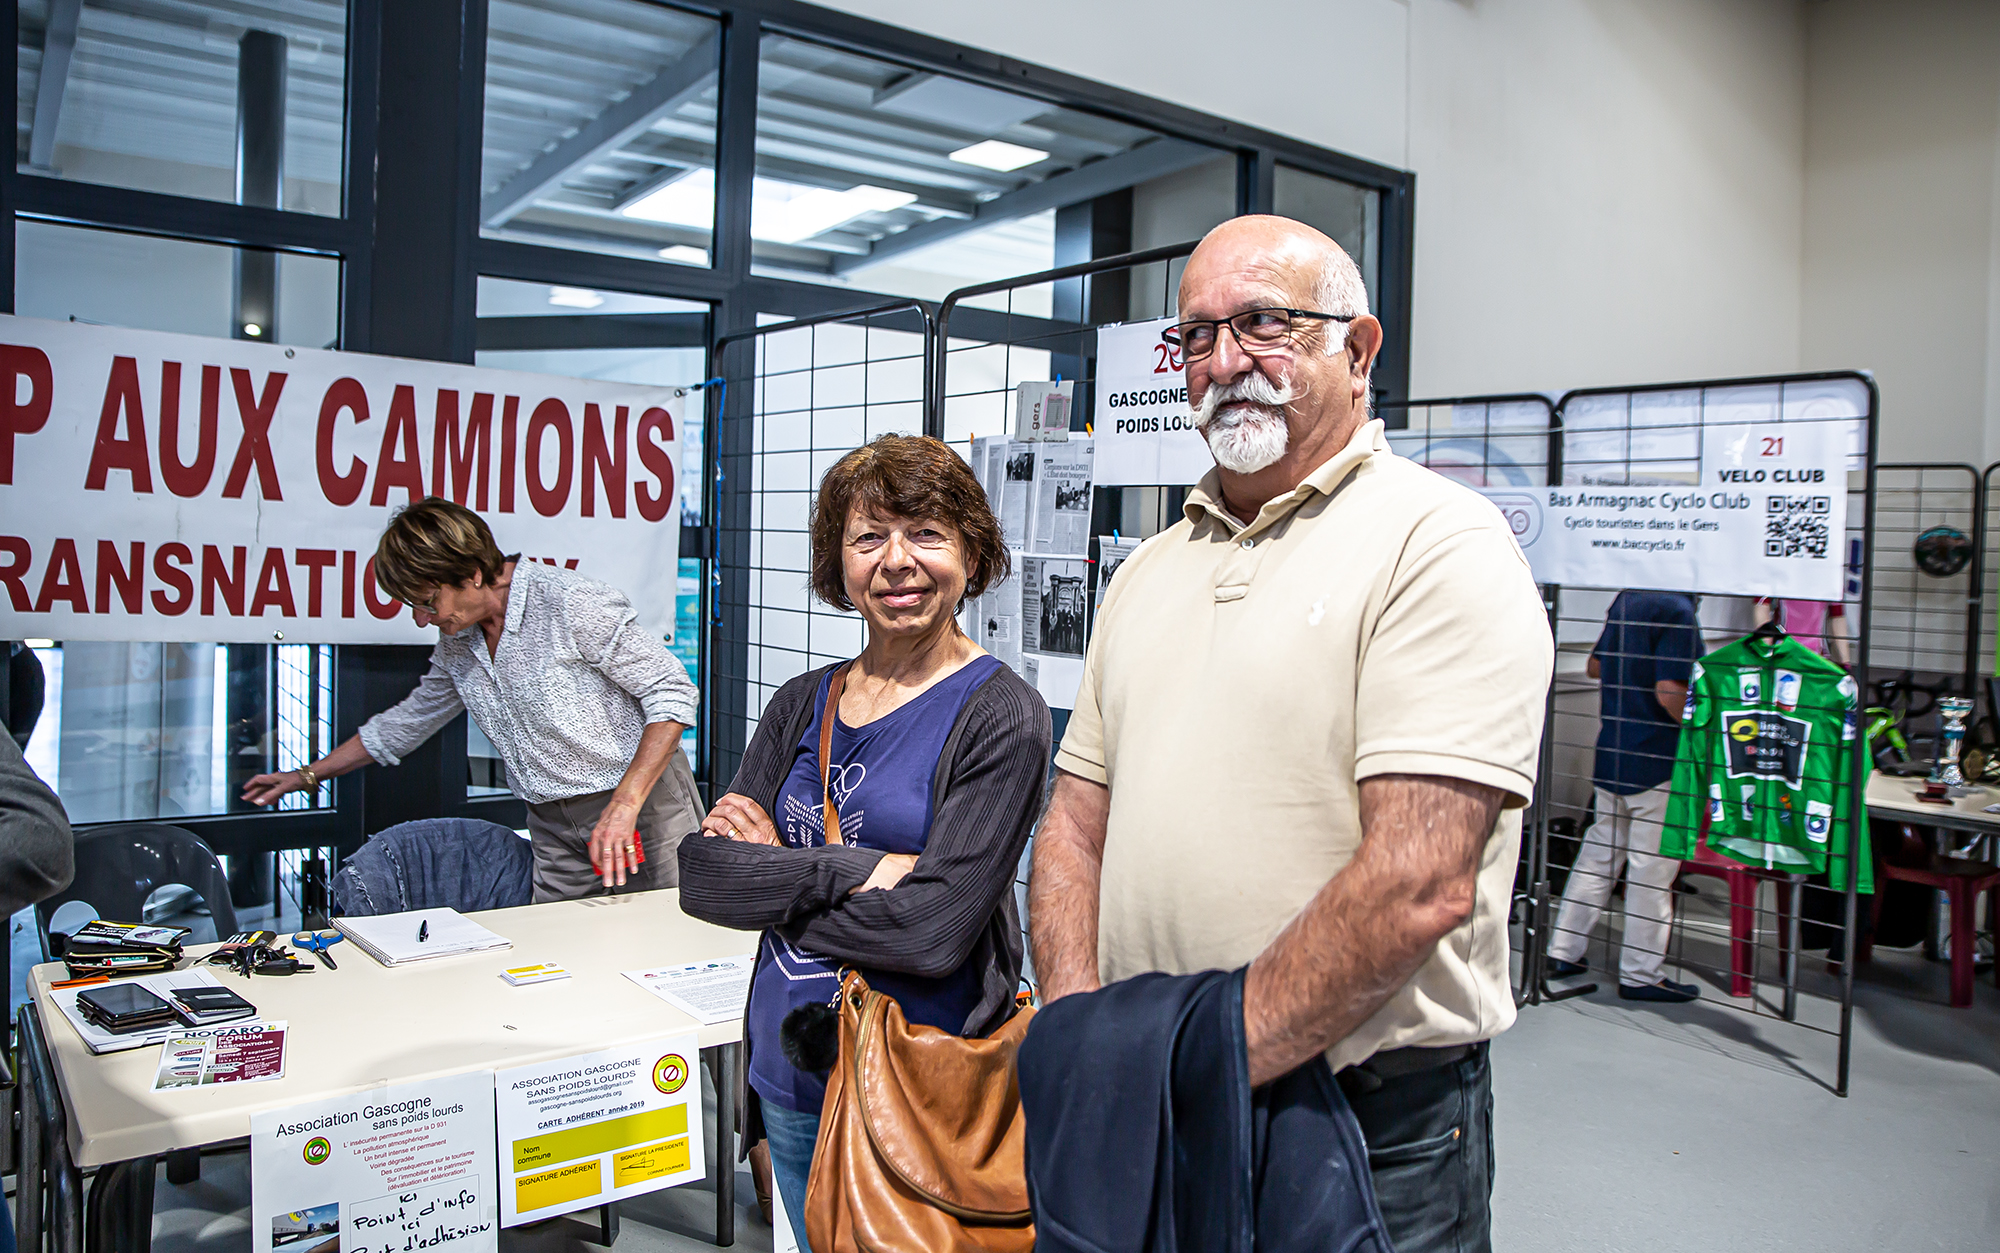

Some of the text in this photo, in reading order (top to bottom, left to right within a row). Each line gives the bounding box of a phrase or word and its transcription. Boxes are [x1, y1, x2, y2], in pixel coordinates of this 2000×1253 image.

[1108, 387, 1188, 408] GASCOGNE
[0, 343, 675, 523] P AUX CAMIONS
[1116, 415, 1199, 434] POIDS LOU
[1760, 436, 1784, 457] 21
[1718, 468, 1826, 483] VELO CLUB
[1548, 492, 1751, 512] Bas Armagnac Cyclo Club
[1563, 516, 1720, 531] Cyclo touristes dans le Gers
[1590, 538, 1686, 553] www.baccyclo.fr
[185, 1025, 264, 1038] NOGARO
[217, 1033, 263, 1042] FORUM
[217, 1040, 274, 1049] ASSOCIATIONS
[248, 1046, 280, 1055] septembre
[511, 1058, 641, 1090] ASSOCIATION GASCOGNE
[526, 1070, 636, 1099] SANS POIDS LOURDS
[276, 1096, 432, 1138] Association Gascogne
[372, 1103, 464, 1131] sans poids lourds
[537, 1100, 645, 1130] CARTE ADHÉRENT année 2019
[350, 1136, 378, 1147] insécurité
[378, 1129, 413, 1142] permanente
[424, 1124, 430, 1132] la
[430, 1122, 436, 1130] D
[436, 1121, 447, 1129] 931
[362, 1143, 387, 1154] pollution
[388, 1134, 430, 1148] atmosphérique
[364, 1154, 374, 1162] Un
[374, 1152, 388, 1160] bruit
[388, 1147, 409, 1156] intense
[417, 1139, 447, 1151] permanent
[517, 1152, 552, 1165] commune
[523, 1146, 541, 1155] Nom
[620, 1150, 647, 1162] SIGNATURE
[655, 1141, 684, 1152] PRESIDENTE
[369, 1155, 415, 1170] Voirie dégradée
[380, 1169, 392, 1177] Des
[393, 1159, 434, 1173] conséquences
[451, 1150, 475, 1160] tourisme
[386, 1176, 398, 1184] Sur
[398, 1168, 430, 1181] l'immobilier
[437, 1164, 443, 1172] le
[443, 1159, 473, 1171] patrimoine
[387, 1177, 423, 1192] (dévaluation
[518, 1162, 597, 1188] SIGNATURE ADHÉRENT
[353, 1206, 406, 1230] Point
